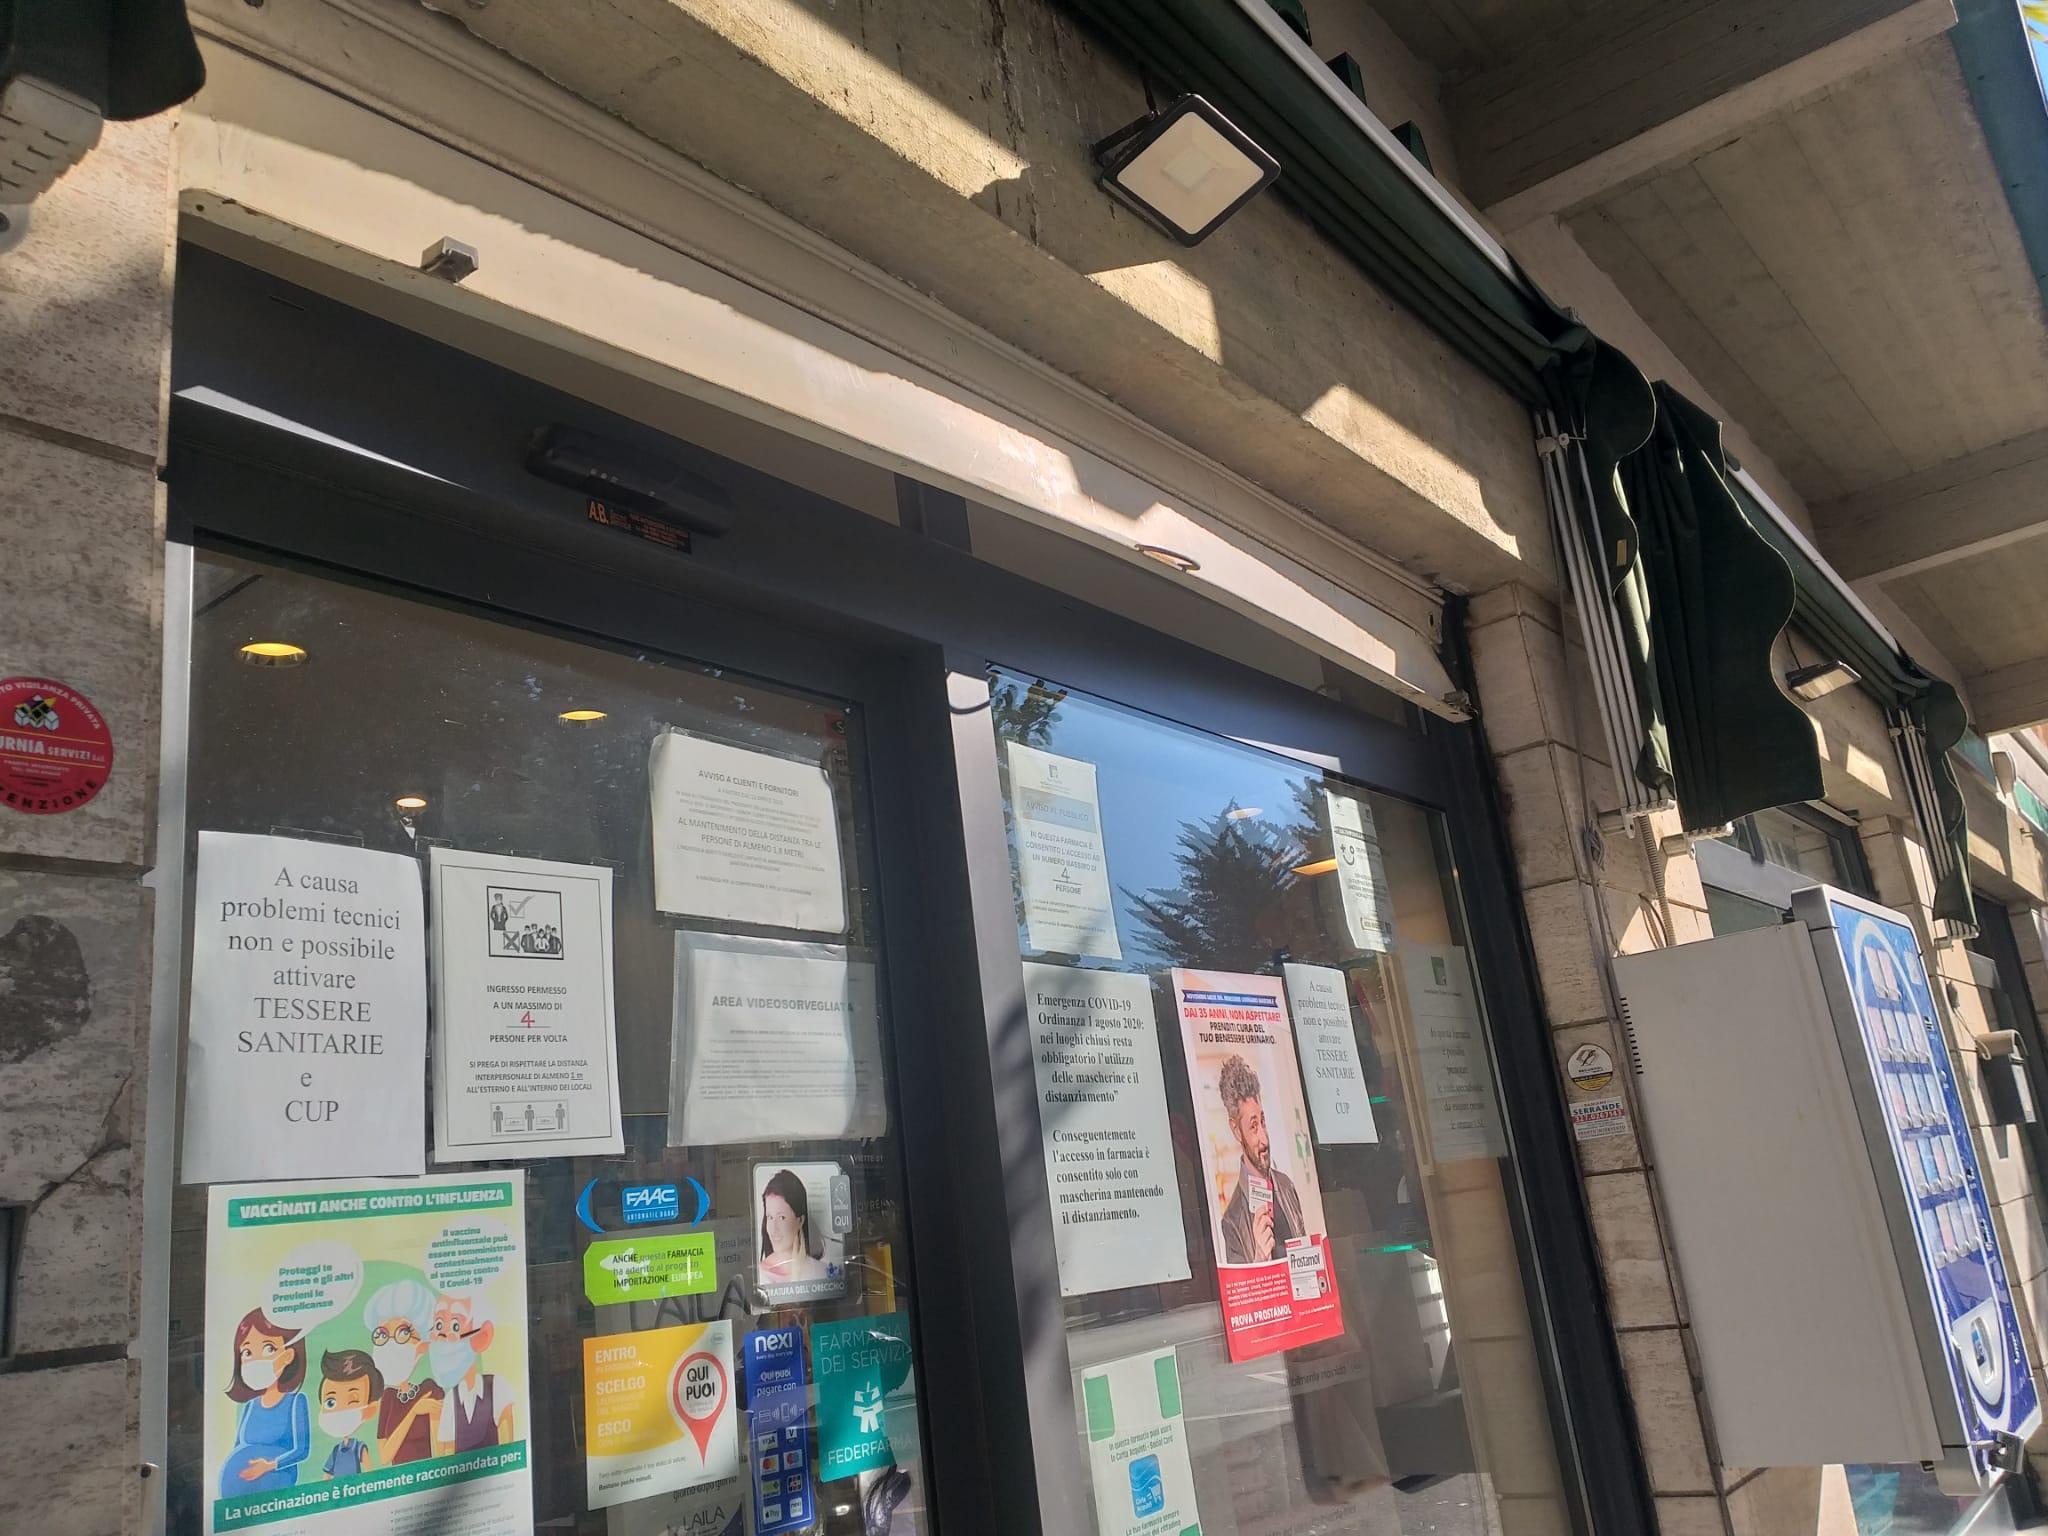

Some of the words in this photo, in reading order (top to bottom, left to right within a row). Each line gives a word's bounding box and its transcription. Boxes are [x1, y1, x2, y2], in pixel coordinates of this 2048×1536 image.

[698, 769, 725, 782] AVVISO
[733, 776, 757, 789] CLIENTI
[764, 784, 800, 798] FORNITORI
[678, 816, 688, 826] AL
[689, 818, 747, 836] MANTENIMENTO
[748, 828, 768, 840] DELLA
[769, 832, 800, 846] DISTANZA
[801, 837, 814, 847] TRA
[701, 834, 733, 847] PERSONE
[743, 841, 772, 853] ALMENO
[784, 846, 805, 859] METRI
[275, 867, 292, 888] A
[300, 874, 358, 894] causa
[220, 898, 325, 924] problemi
[334, 905, 400, 931] tecnici
[229, 933, 273, 952] non
[282, 938, 293, 952] e
[301, 932, 395, 961] possibile
[273, 965, 356, 989] attivare
[487, 985, 526, 994] INGRESSO
[527, 986, 567, 995] PERMESSO
[1317, 984, 1332, 995] causa
[254, 996, 372, 1023] TESSERE
[493, 1001, 500, 1009] A
[501, 1002, 513, 1010] UN
[515, 1002, 552, 1010] MASSIMO
[712, 996, 743, 1008] AREA
[747, 997, 854, 1013] VIDEOSORVEGLIATA
[1037, 992, 1086, 1012] Emergenza
[1087, 997, 1132, 1012] COVID-19
[1298, 997, 1325, 1011] problemi
[520, 1011, 535, 1028] 4
[1038, 1013, 1085, 1028] Ordinanza
[1095, 1016, 1121, 1031] agosto
[1184, 1008, 1198, 1018] DAI
[1199, 1008, 1207, 1018] 35
[1209, 1009, 1229, 1020] ANNI,
[1229, 1010, 1244, 1020] NON
[1245, 1011, 1281, 1022] ASPETTARE!
[1323, 1015, 1348, 1030] possibile
[1210, 1022, 1236, 1032] PRENDITI
[1237, 1023, 1253, 1033] CURA
[1254, 1024, 1265, 1033] DEL
[237, 1031, 384, 1056] SANITARIE
[490, 1034, 526, 1043] PERSONE
[527, 1035, 542, 1043] PER
[544, 1035, 568, 1043] VOLTA
[1040, 1033, 1053, 1045] nei
[1055, 1033, 1083, 1048] luoghi
[1085, 1034, 1111, 1047] chiusi
[1112, 1036, 1133, 1048] resta
[1199, 1033, 1213, 1042] TUO
[1215, 1033, 1245, 1044] BENESSERE
[1319, 1033, 1342, 1046] attivare
[1041, 1051, 1096, 1068] obbligatorio
[1097, 1052, 1134, 1066] l'utilizzo
[1316, 1048, 1349, 1062] TESSERE
[509, 1060, 547, 1068] RISPETTARE
[1316, 1065, 1355, 1080] SANITARIE
[300, 1071, 312, 1088] e
[475, 1073, 531, 1081] INTERPERSONALE
[542, 1072, 569, 1080] ALMENO
[1051, 1070, 1074, 1084] delle
[1076, 1070, 1126, 1084] mascherine
[466, 1085, 510, 1094] ALL'ESTERNO
[517, 1084, 558, 1092] ALL'INTERNO
[571, 1082, 592, 1091] LOCALI
[284, 1100, 339, 1122] CUP
[1335, 1102, 1350, 1115] CUP
[1573, 1102, 1621, 1115] SERRANDE
[1052, 1128, 1136, 1144] Conseguentemente
[1052, 1148, 1094, 1163] l'accesso
[1096, 1148, 1105, 1161] in
[1106, 1146, 1143, 1160] farmacia
[1056, 1168, 1103, 1183] consentito
[1105, 1168, 1122, 1181] solo
[1123, 1169, 1138, 1180] con
[318, 1197, 368, 1213] ANCHE
[369, 1193, 424, 1210] CONTRO
[425, 1188, 505, 1206] L'INFLUENZA
[626, 1188, 676, 1207] FAAC
[1059, 1188, 1112, 1204] mascherina
[1113, 1185, 1164, 1200] mantenendo
[834, 1214, 849, 1227] QUI
[1061, 1211, 1070, 1225] il
[1072, 1209, 1140, 1224] distanziamento.
[612, 1252, 638, 1264] ANCHE
[666, 1246, 704, 1260] FARMACIA
[1290, 1251, 1320, 1269] Prostamol
[279, 1264, 321, 1279] Proteggi
[625, 1262, 655, 1275] aderito
[279, 1276, 311, 1288] stesso
[334, 1271, 354, 1284] altri
[446, 1276, 483, 1289] Covid-19
[613, 1273, 670, 1289] IMPORTAZIONE
[272, 1290, 314, 1304] Previeni
[765, 1284, 793, 1297] ORATURA
[811, 1281, 845, 1293] ORECCHIO
[272, 1299, 334, 1315] complicanze
[1230, 1314, 1255, 1329] PROVA
[1255, 1304, 1292, 1323] PROSTAMOL
[755, 1331, 793, 1353] nexi
[595, 1344, 637, 1364] ENTRO
[821, 1355, 844, 1375] DEI
[859, 1345, 907, 1370] SERVIZI
[686, 1365, 709, 1383] QUI
[760, 1370, 775, 1383] Qui
[775, 1368, 792, 1382] puoi
[595, 1375, 647, 1397] SCELGO
[686, 1382, 715, 1401] PUOI
[757, 1384, 783, 1398] pagare
[784, 1382, 797, 1393] con
[597, 1418, 632, 1437] ESCO
[224, 1507, 241, 1522] La
[243, 1486, 330, 1517] vaccinazione
[331, 1484, 341, 1500] è
[342, 1473, 414, 1498] fortemente
[415, 1456, 499, 1483] raccomandata
[499, 1450, 523, 1468] per:
[681, 1505, 727, 1532] LAILA
